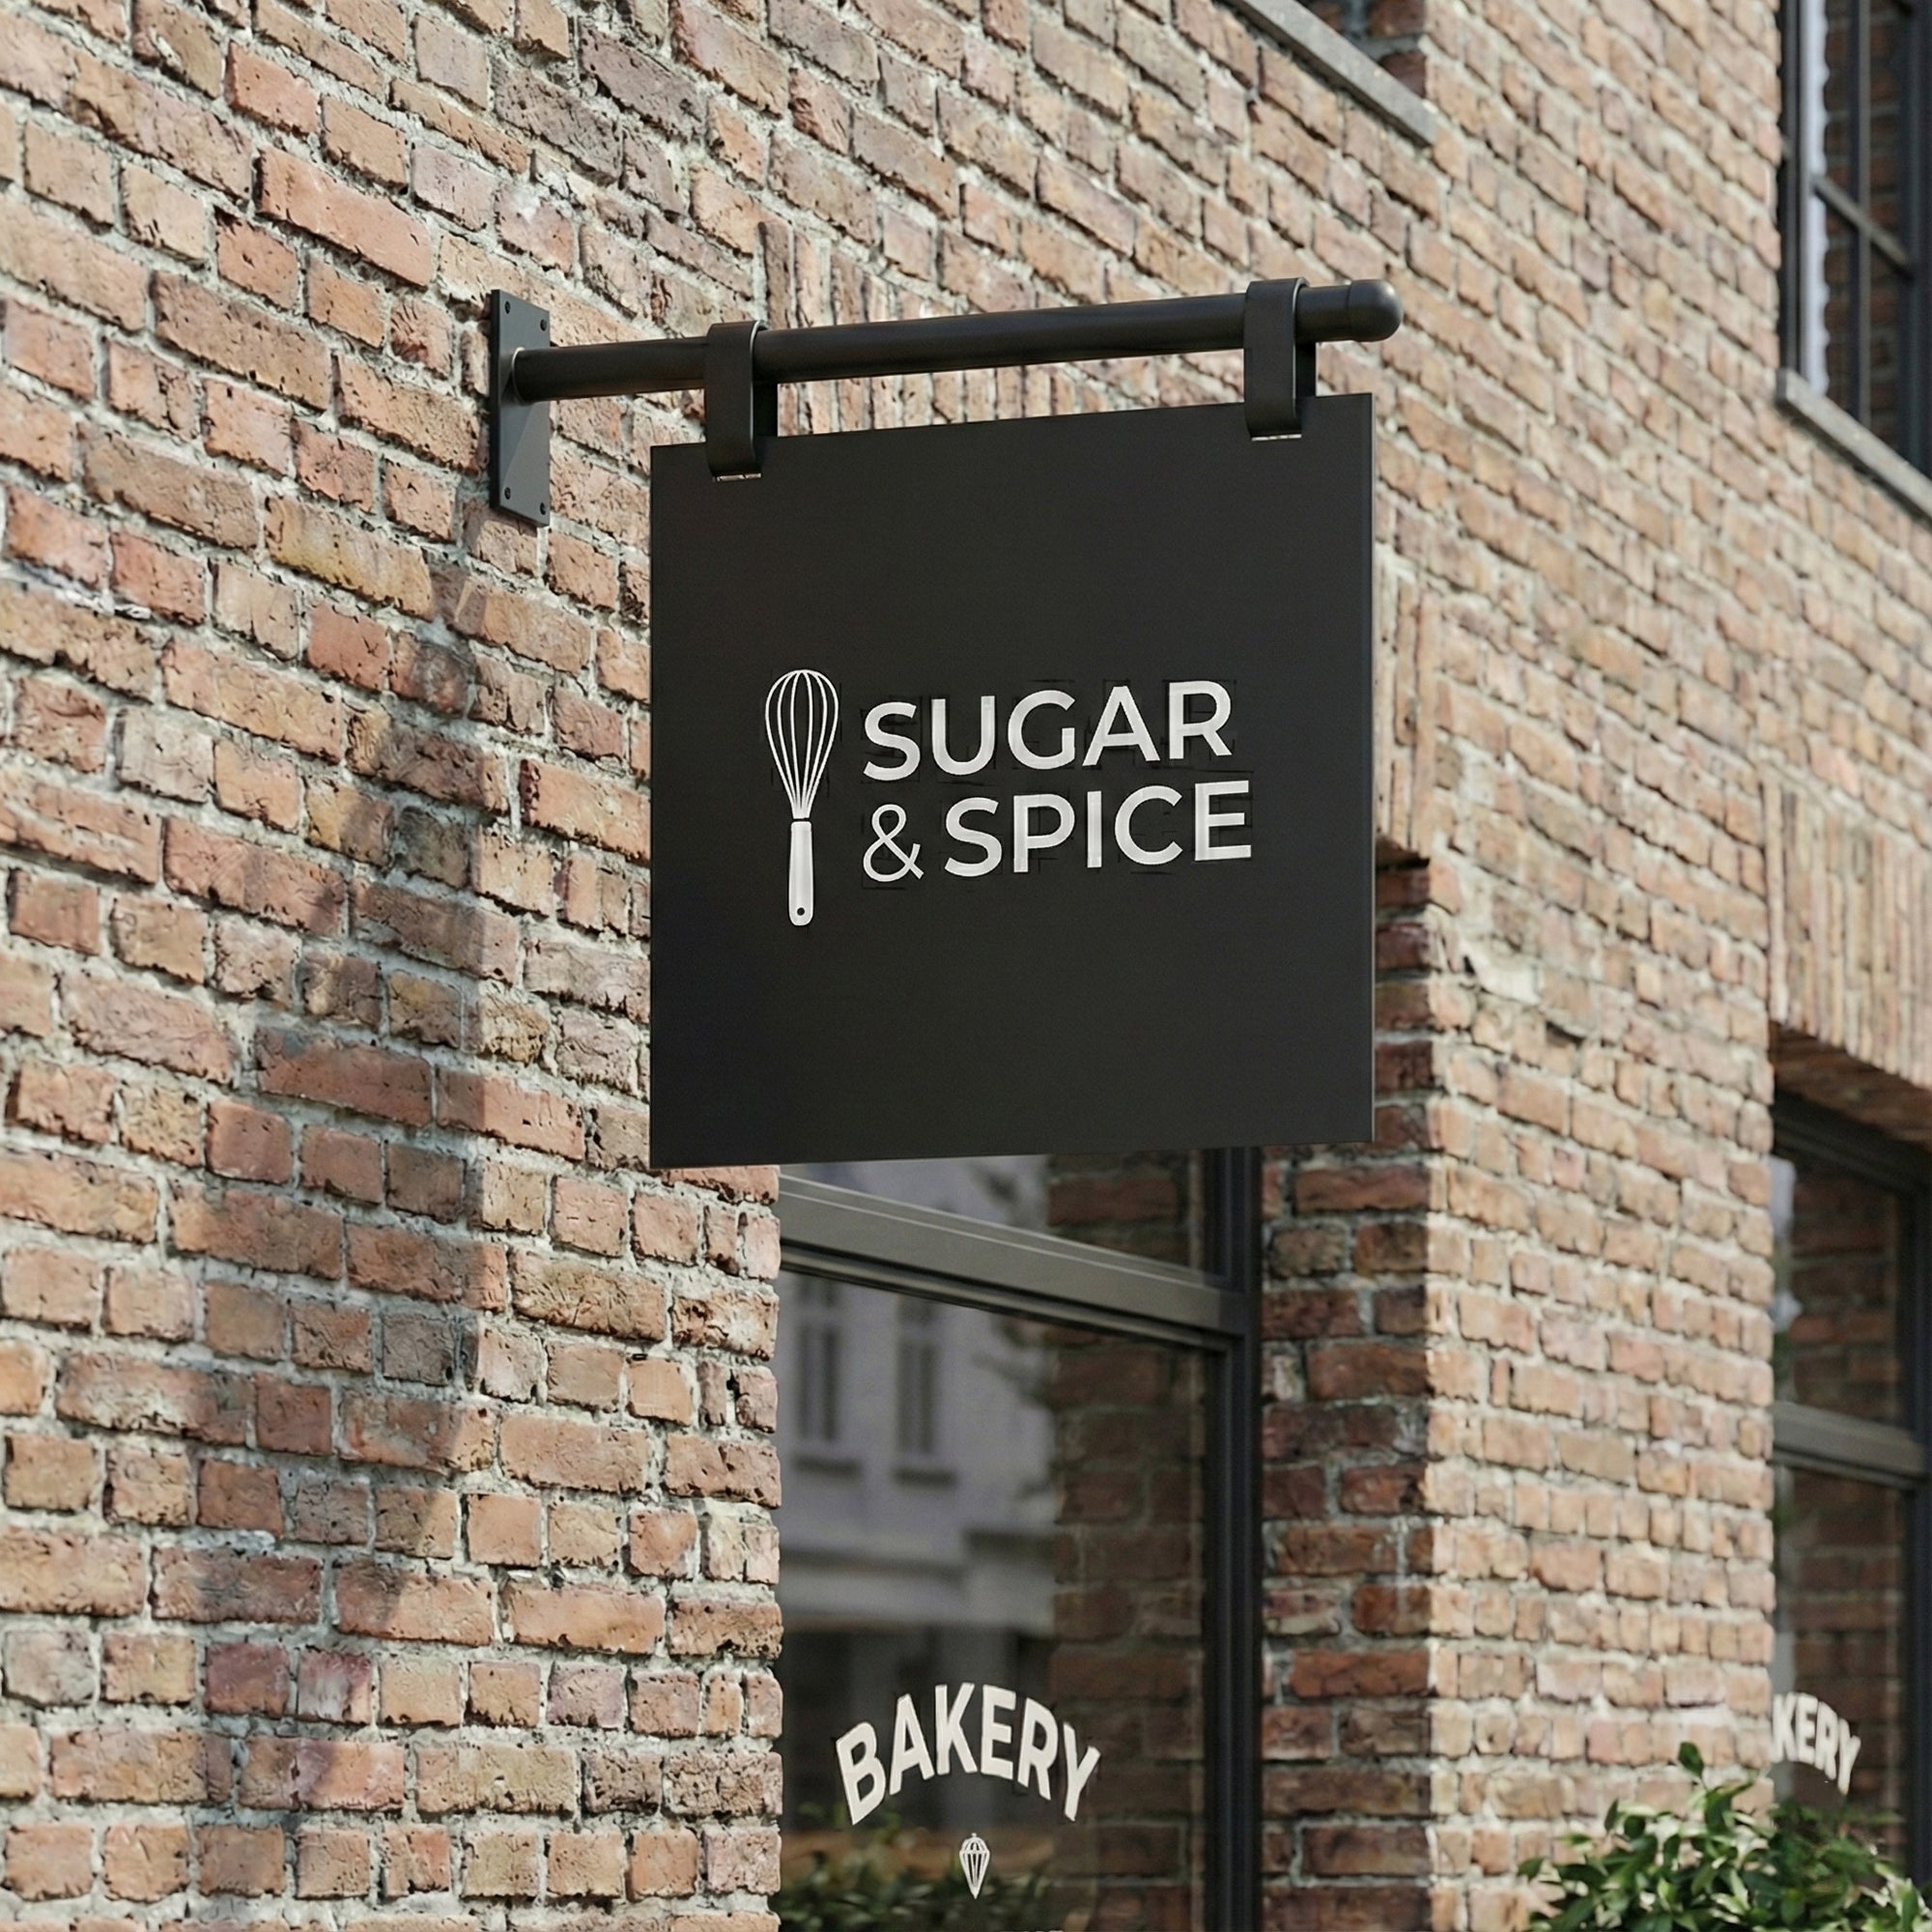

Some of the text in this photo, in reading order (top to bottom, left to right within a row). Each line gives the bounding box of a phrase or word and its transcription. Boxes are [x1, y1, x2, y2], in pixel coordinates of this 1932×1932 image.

[863, 680, 1233, 781] SUGAR
[863, 780, 1252, 883] & SPICE
[836, 1682, 1101, 1826] BAKERY
[1770, 1691, 1861, 1796] KERY
